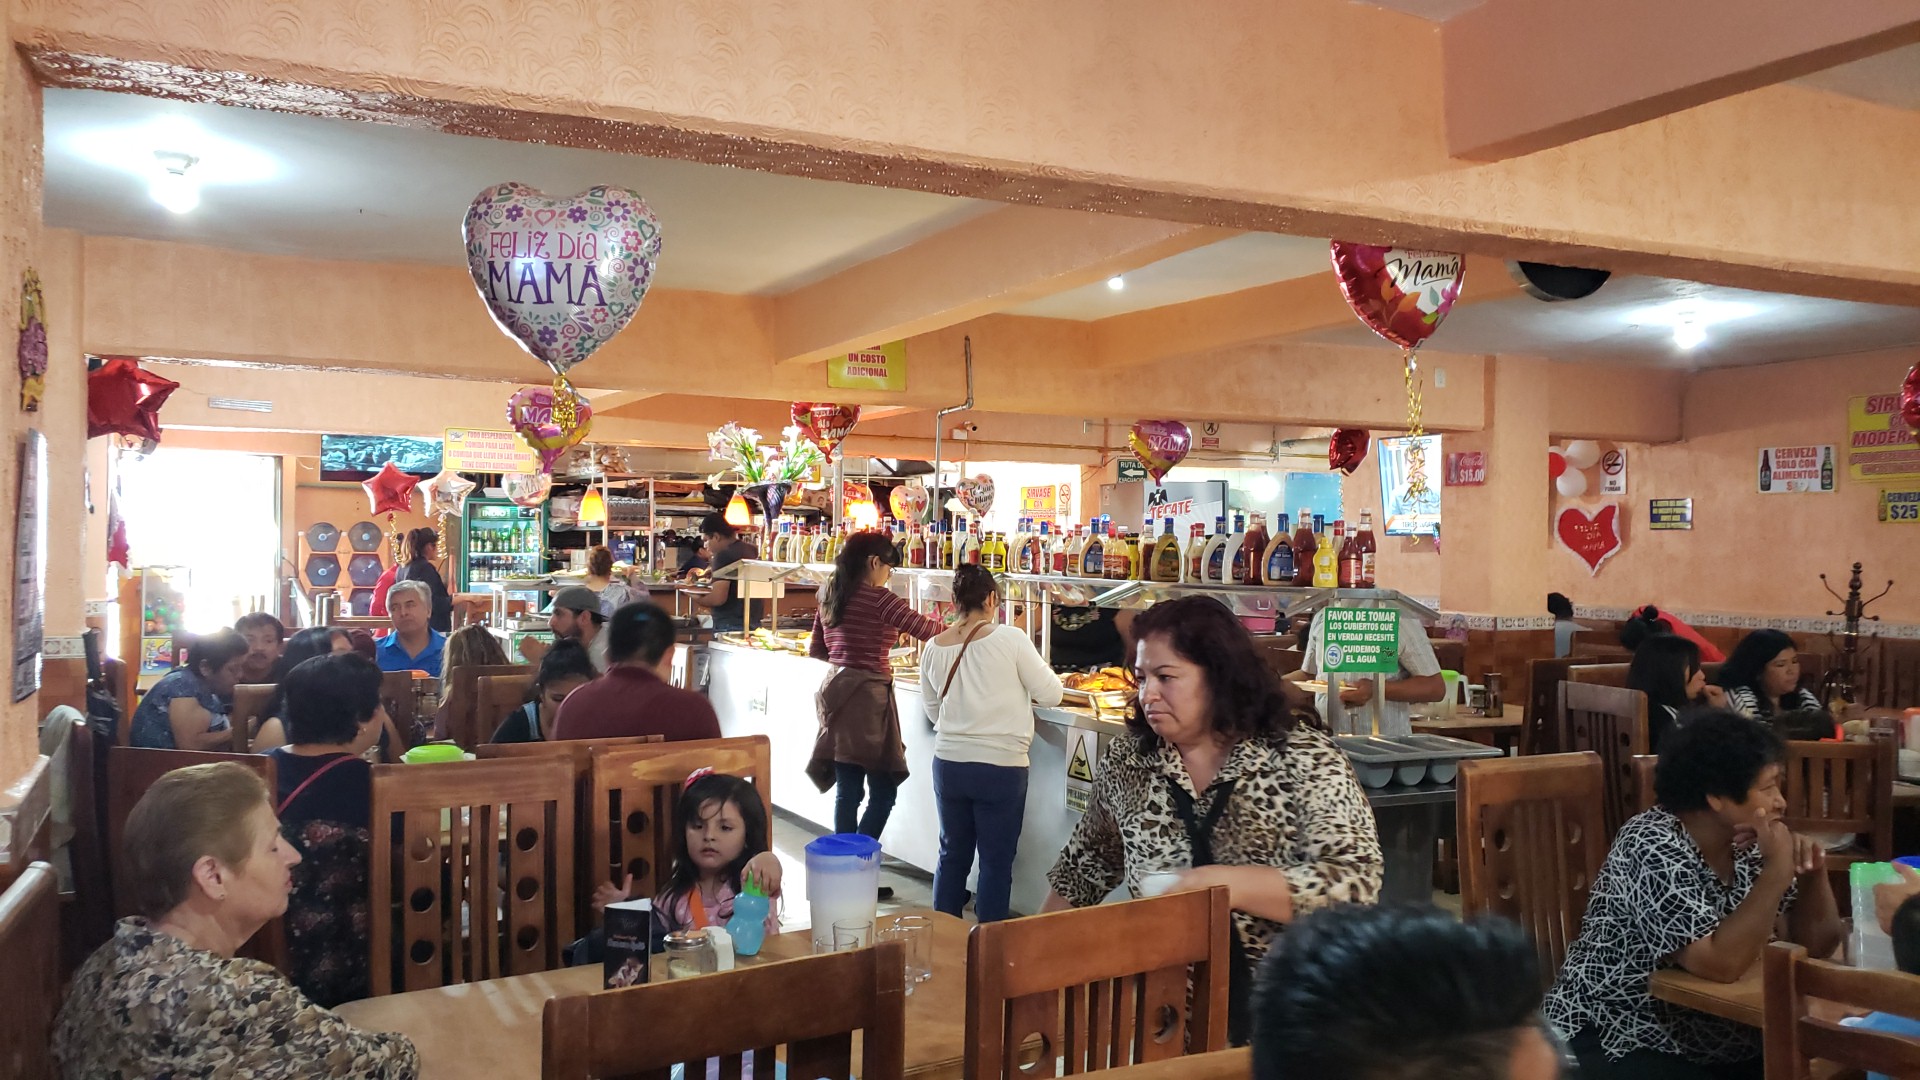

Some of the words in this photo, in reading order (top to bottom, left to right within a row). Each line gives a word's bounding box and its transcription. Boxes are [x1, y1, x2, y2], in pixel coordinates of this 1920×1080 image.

[1374, 257, 1460, 288] Mamá
[487, 260, 609, 306] MAMÁ
[848, 353, 859, 363] UN
[860, 353, 887, 364] COSTO
[847, 366, 888, 378] ADICIONAL
[1775, 446, 1818, 459] CERVEZA
[1120, 461, 1137, 469] RUTA
[1776, 460, 1797, 469] SOLO
[1798, 459, 1817, 468] CON
[1460, 468, 1485, 483] $15.00
[1772, 469, 1819, 480] ALIMENTOS
[1027, 487, 1052, 498] SIRVASE
[1148, 499, 1194, 520] TECATE
[1890, 504, 1918, 520] $25
[1328, 610, 1354, 621] FAVOR
[1355, 611, 1367, 621] DE
[1368, 611, 1396, 622] TOMAR
[1329, 622, 1342, 630] LOS
[1343, 622, 1379, 631] CUBIERTOS
[1380, 623, 1394, 631] QUE
[1327, 632, 1337, 641] EN
[1337, 632, 1363, 641] VERDAD
[1364, 633, 1395, 642] NECESITE
[1342, 644, 1380, 653] CUIDEMOS
[1345, 655, 1355, 663] EL
[1356, 655, 1377, 663] AGUA
